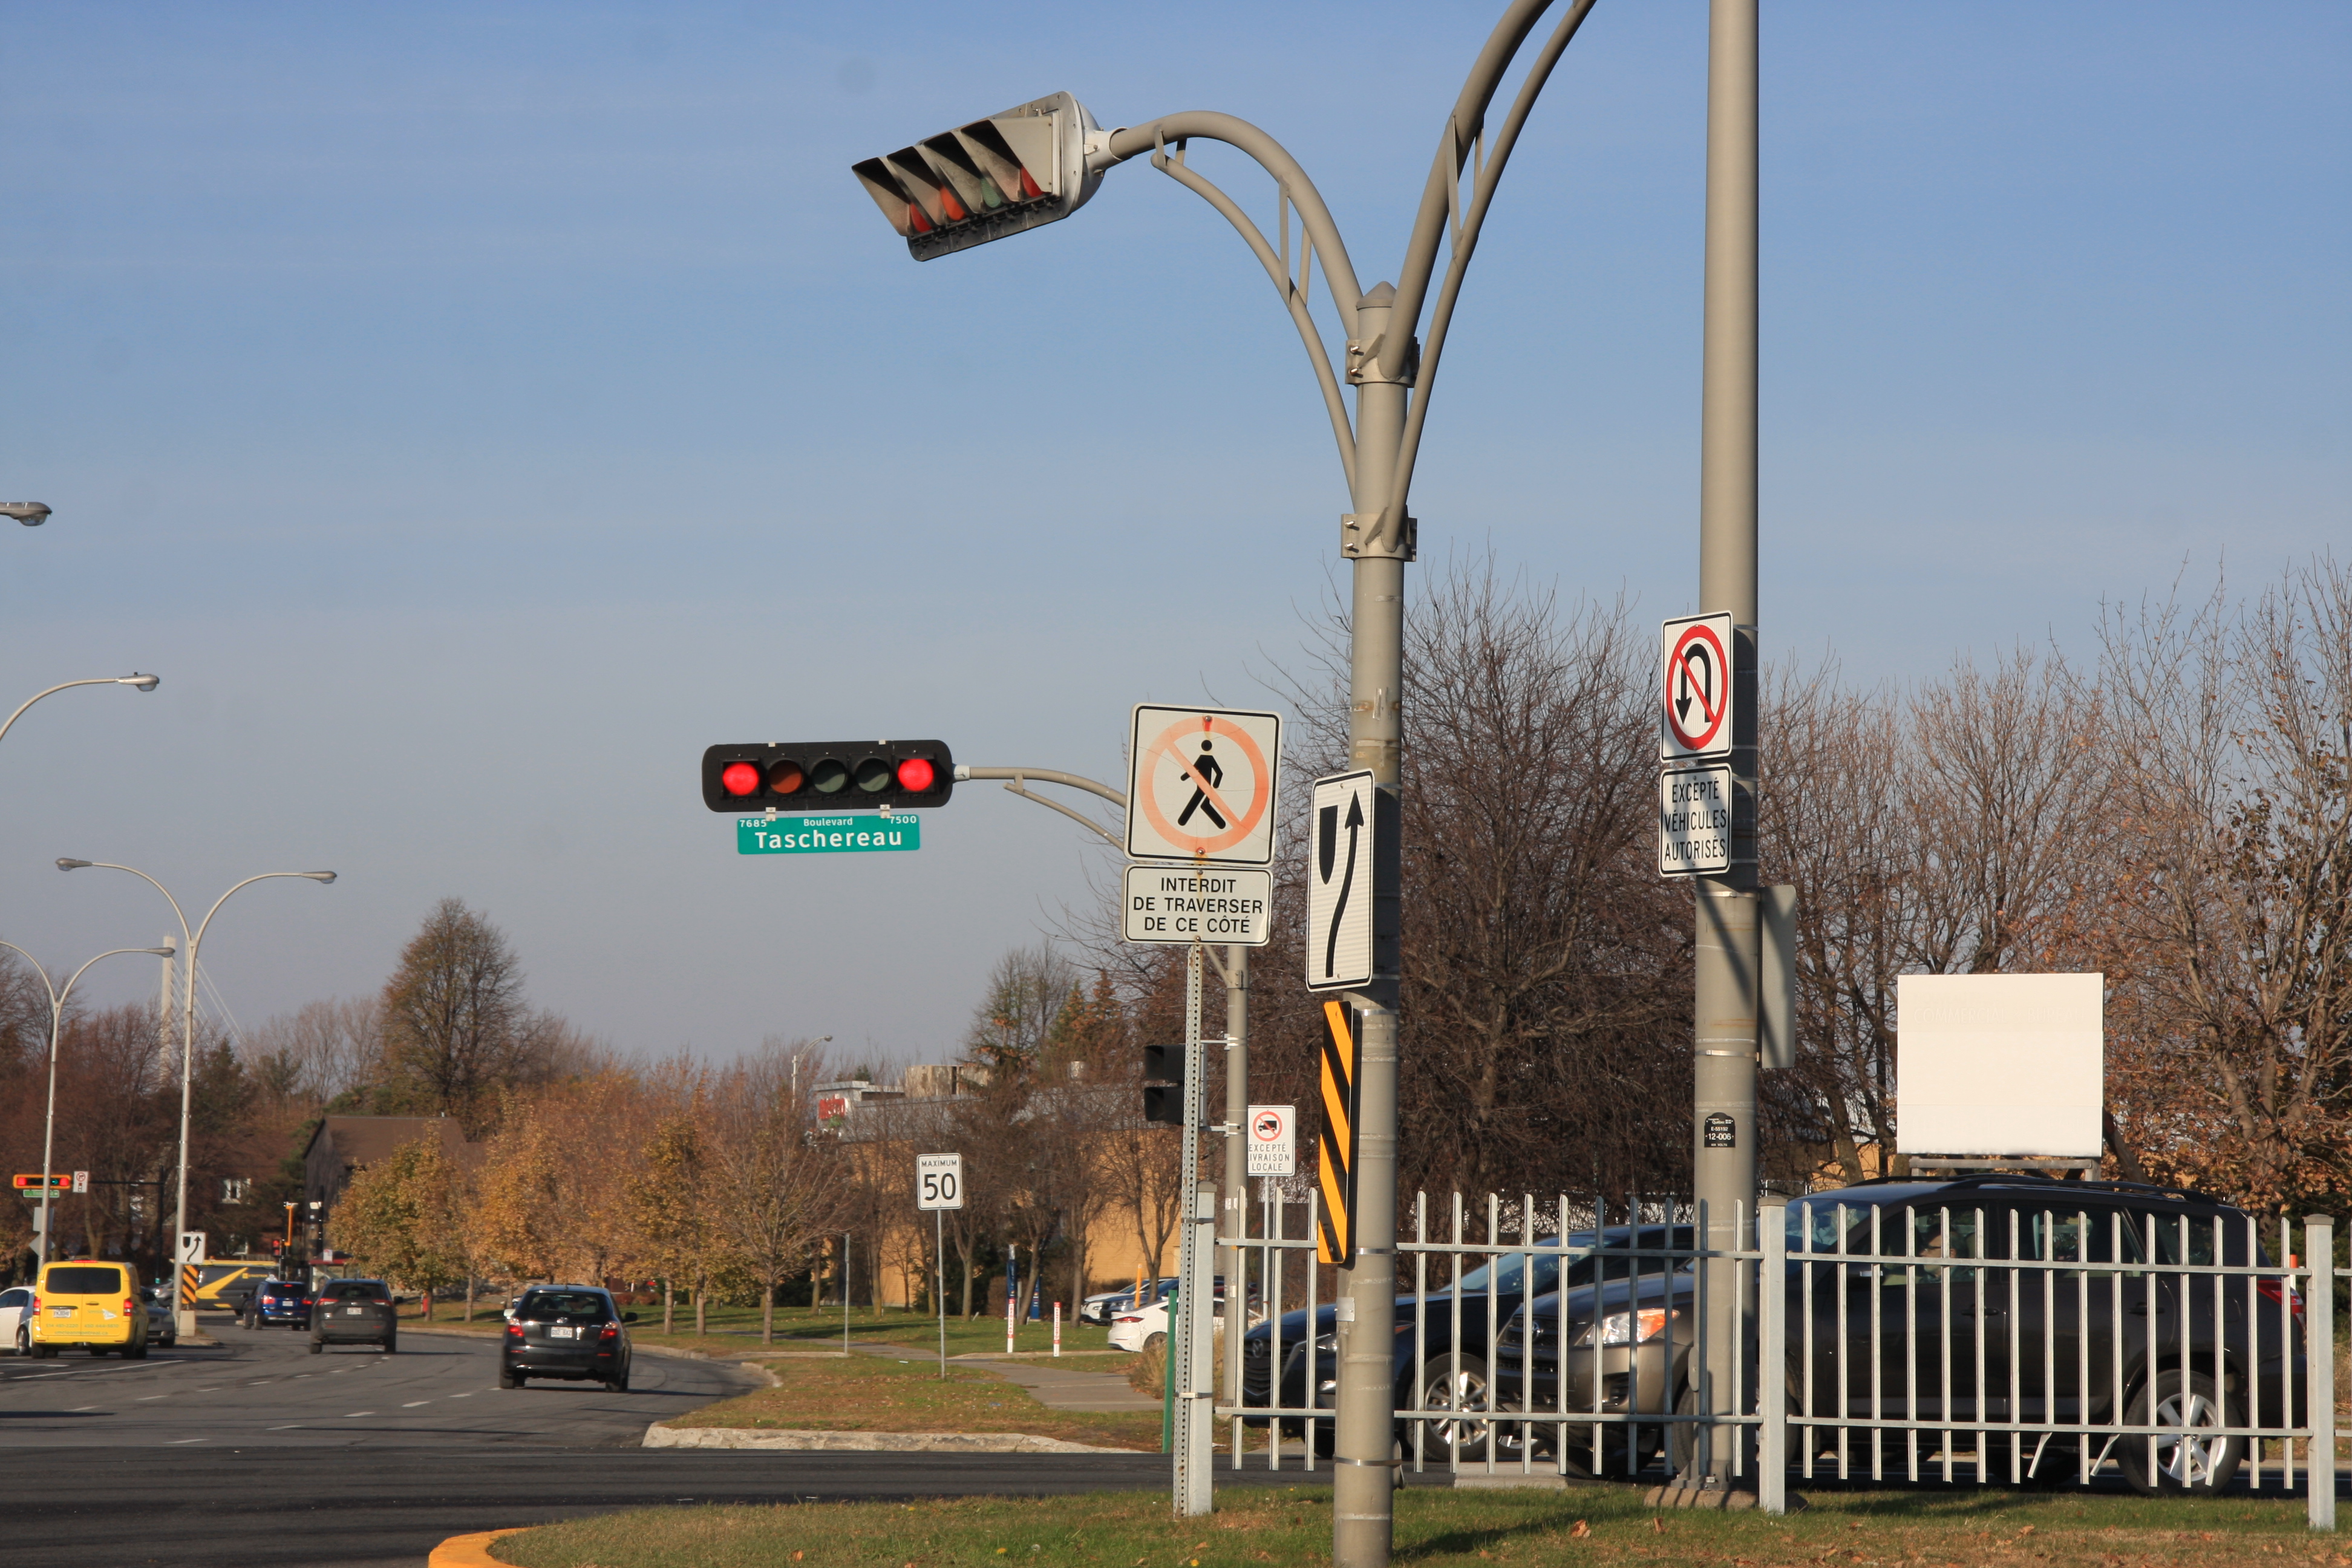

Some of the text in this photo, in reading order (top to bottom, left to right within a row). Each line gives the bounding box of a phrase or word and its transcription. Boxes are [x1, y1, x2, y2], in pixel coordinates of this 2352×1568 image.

[1672, 777, 1719, 803] EXCEPTÉ
[739, 819, 767, 828] 7685
[803, 817, 853, 826] Boulevard
[890, 815, 917, 824] 7500
[1664, 809, 1726, 832] VÉHICULES
[754, 829, 902, 848] Taschereau
[1664, 835, 1726, 861] AUTORISÉS
[1161, 877, 1236, 893] INTERDIT
[1133, 897, 1263, 913] DE TRAVERSER
[1145, 915, 1250, 933] DE CE CÔTÉ
[1249, 1142, 1286, 1152] EXCEPTÉ
[1252, 1163, 1282, 1171] LOCALE
[924, 1173, 956, 1201] 50
